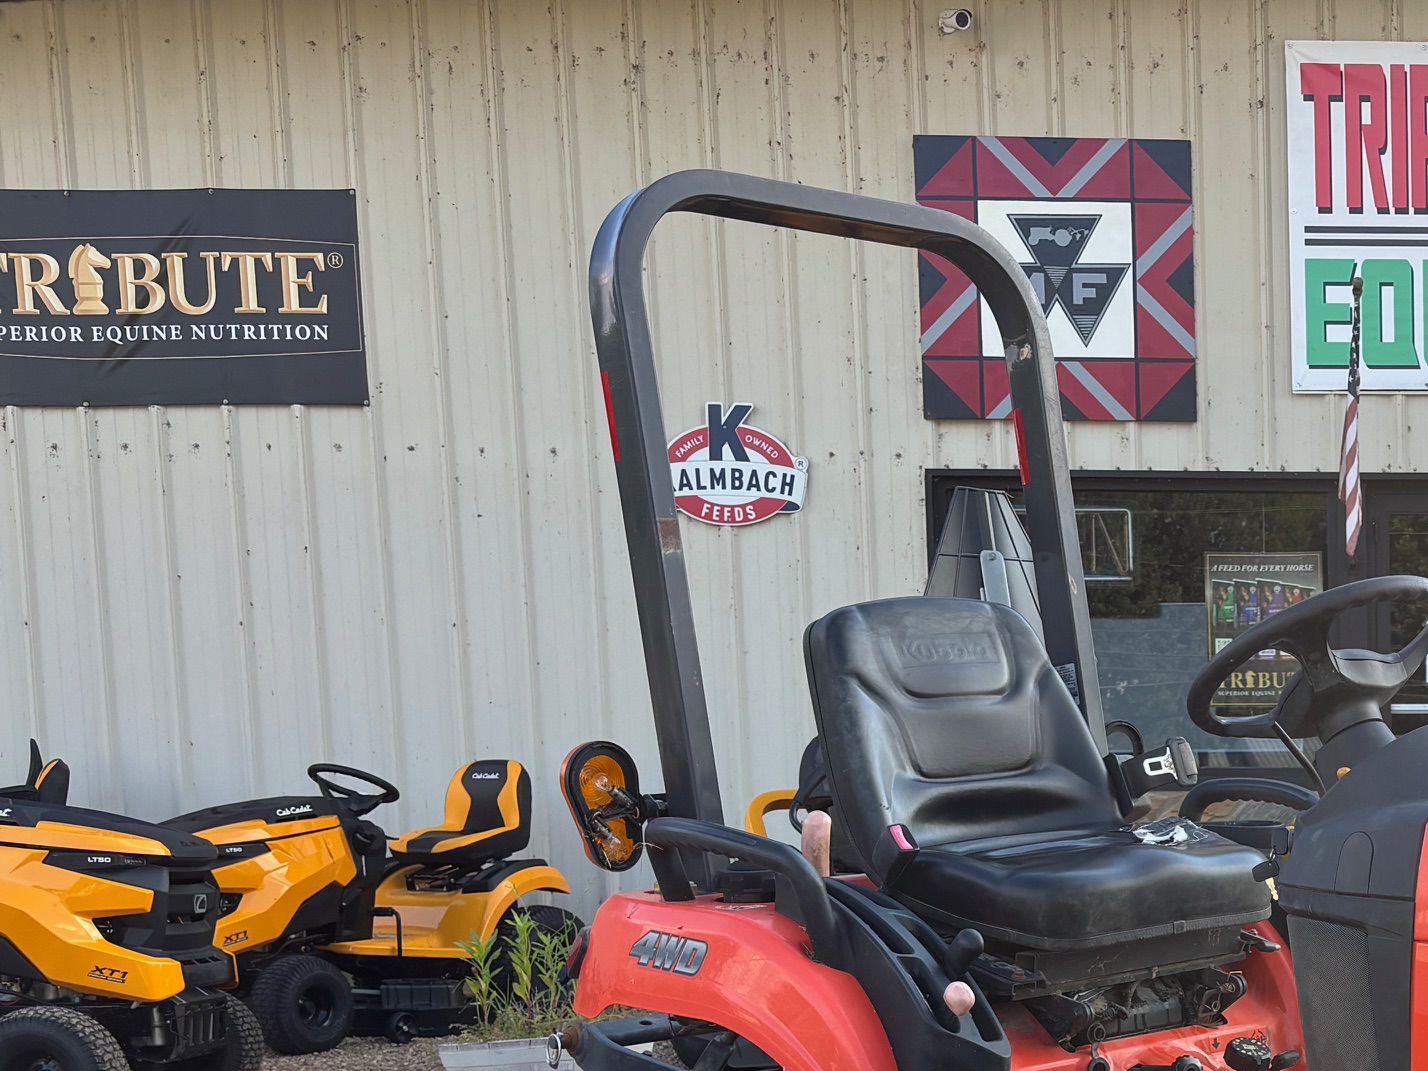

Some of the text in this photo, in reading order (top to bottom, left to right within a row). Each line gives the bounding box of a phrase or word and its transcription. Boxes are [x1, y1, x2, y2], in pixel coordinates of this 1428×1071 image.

[91, 325, 182, 345] EQUINE
[190, 324, 329, 342] NUTRITION
[675, 434, 779, 459] FAMILY OWNED
[672, 467, 796, 497] ALMBACH
[700, 503, 757, 522] FEEDS
[1218, 564, 1240, 572] FEED
[1241, 564, 1259, 572] FOR
[1260, 564, 1287, 572] EVERY
[1286, 563, 1314, 571] HORSE
[629, 929, 709, 977] 4WD
[90, 965, 129, 979] XT1
